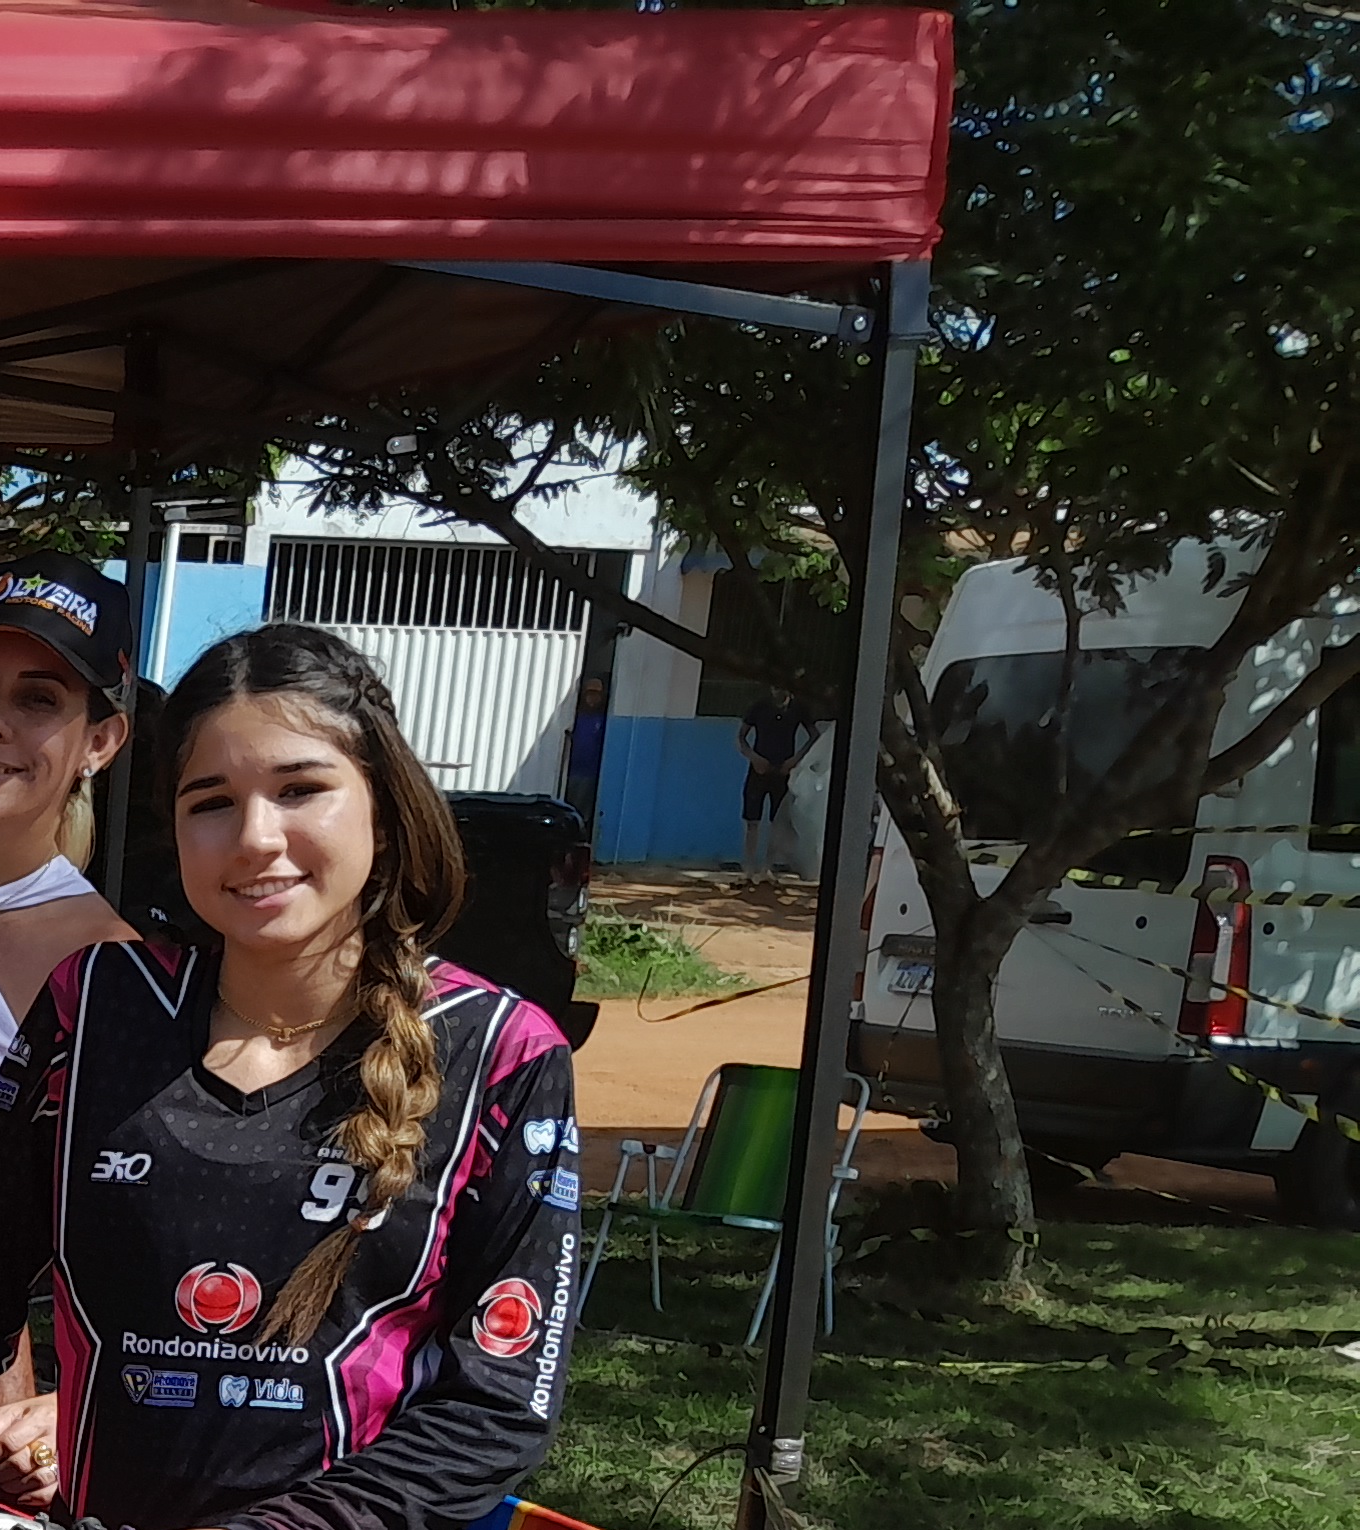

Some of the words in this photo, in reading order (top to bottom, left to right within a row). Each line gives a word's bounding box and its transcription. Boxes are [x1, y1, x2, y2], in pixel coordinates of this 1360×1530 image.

[530, 1233, 575, 1419] Rondoniaovivo
[122, 1331, 310, 1365] Rondoniaovivo
[254, 1378, 304, 1401] Vida
